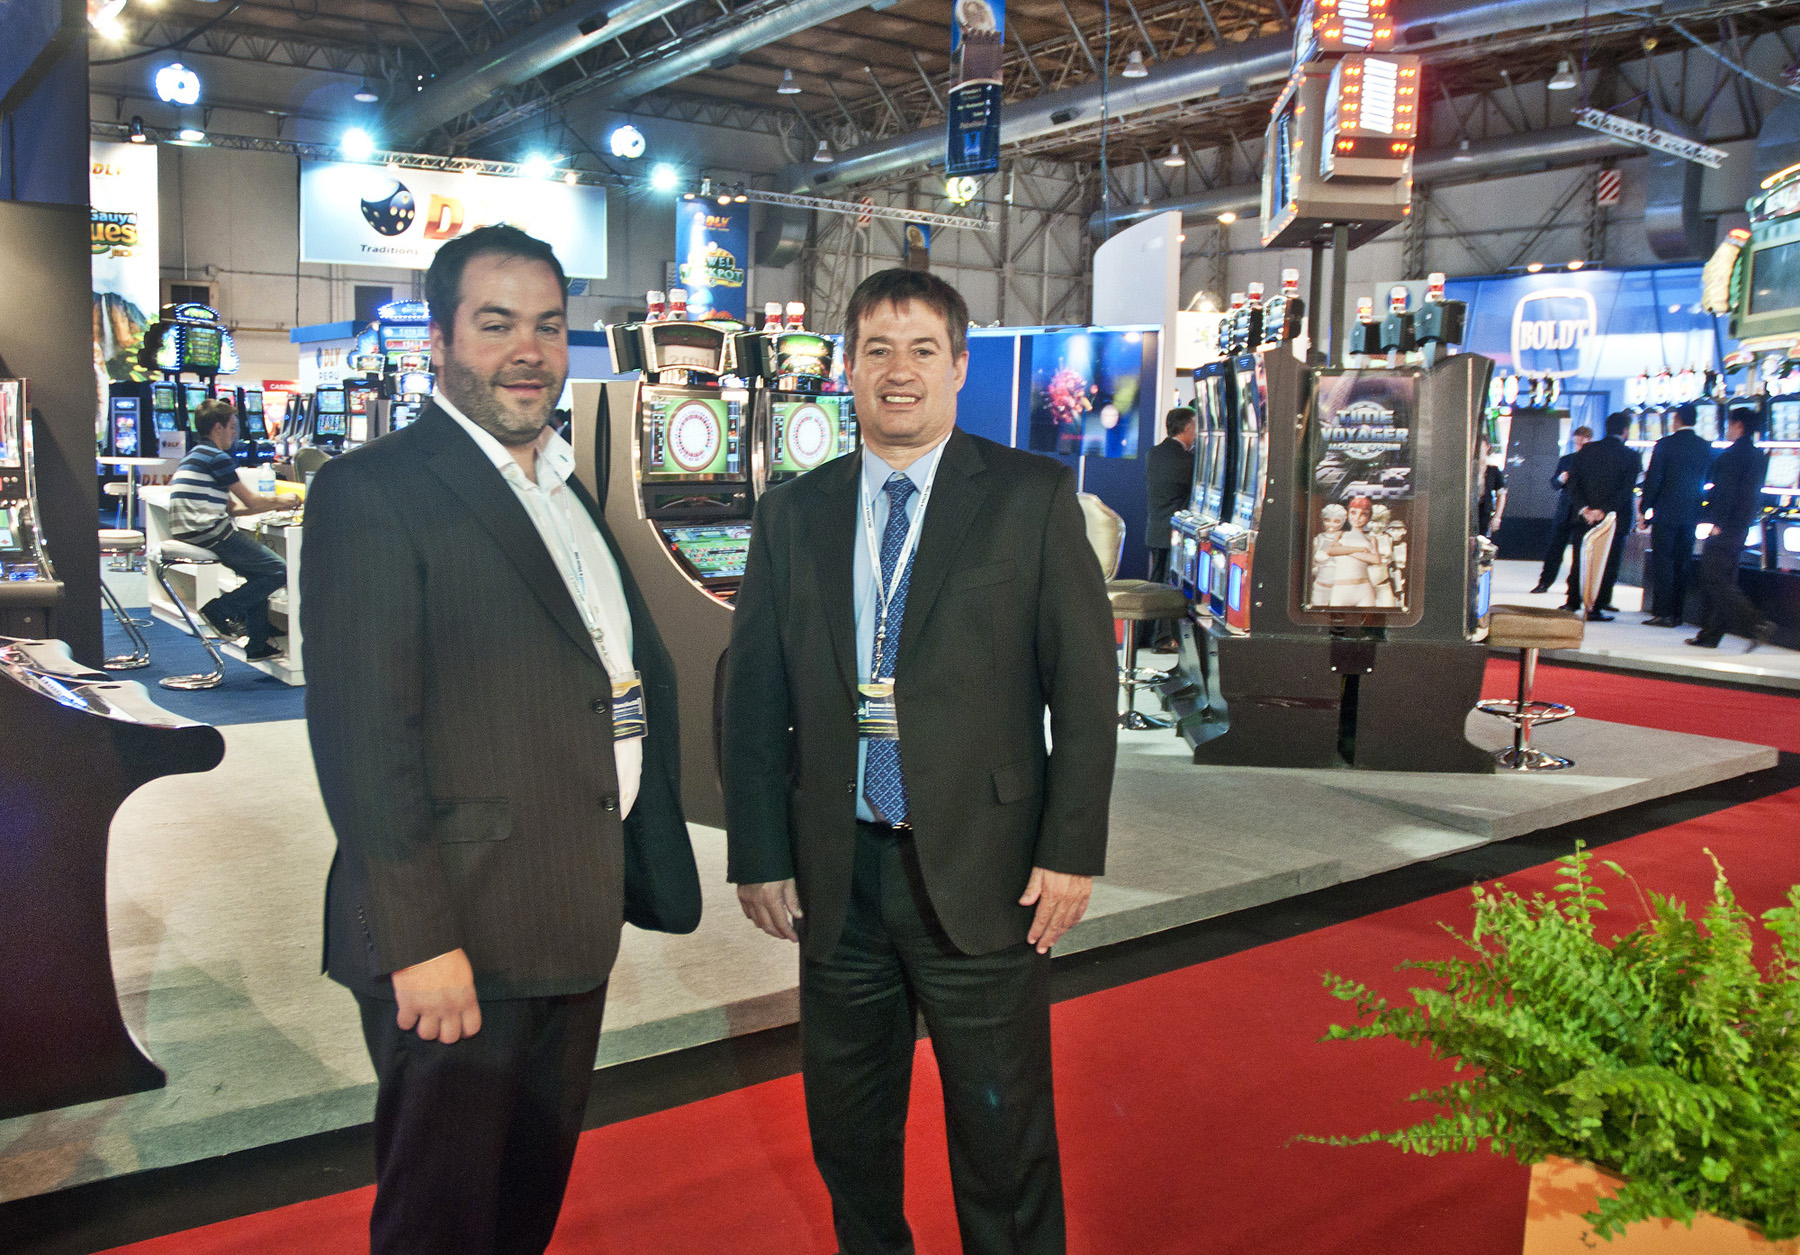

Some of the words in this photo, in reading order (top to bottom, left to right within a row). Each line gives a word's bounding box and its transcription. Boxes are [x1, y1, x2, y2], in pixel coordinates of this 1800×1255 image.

[1520, 320, 1588, 350] BOLDT
[1336, 410, 1395, 424] TIME
[1320, 427, 1409, 442] VOYAGER
